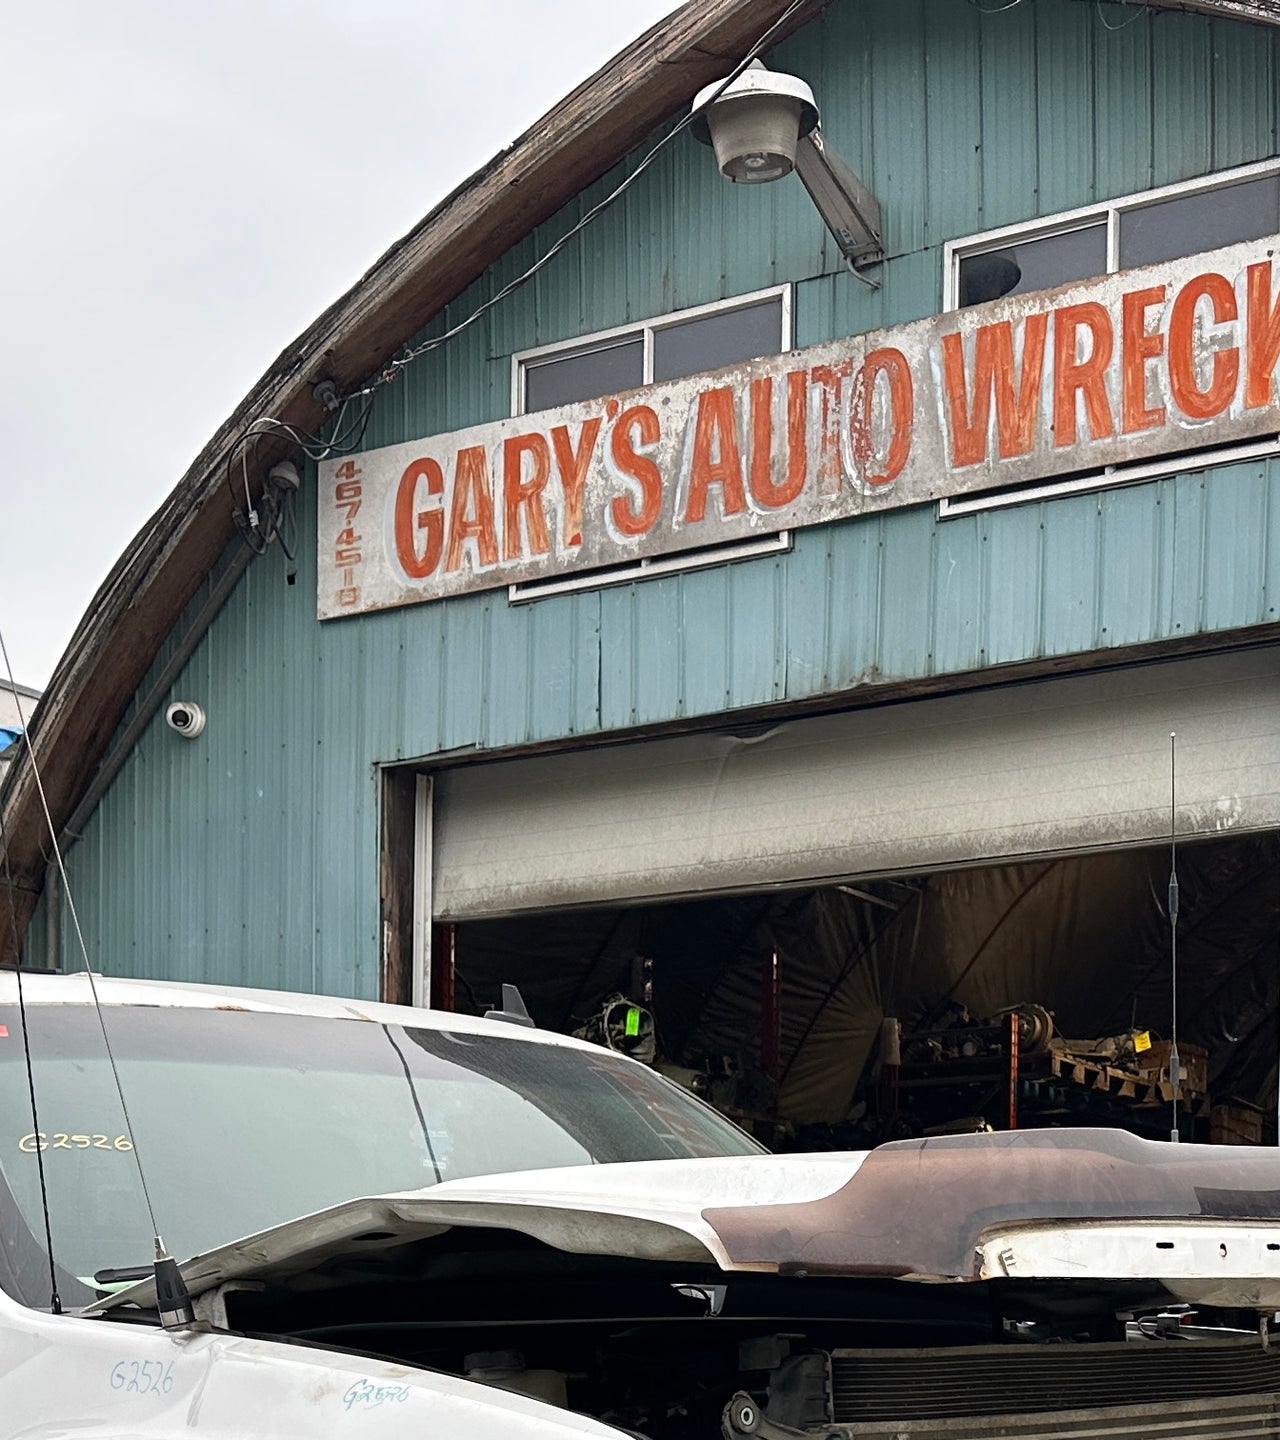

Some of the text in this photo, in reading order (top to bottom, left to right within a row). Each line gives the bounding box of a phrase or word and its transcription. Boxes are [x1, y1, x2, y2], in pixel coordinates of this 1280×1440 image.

[393, 399, 662, 579] GARY'S
[685, 346, 915, 523] AUTO
[18, 1132, 134, 1153] G2526
[110, 1360, 175, 1396] G2526
